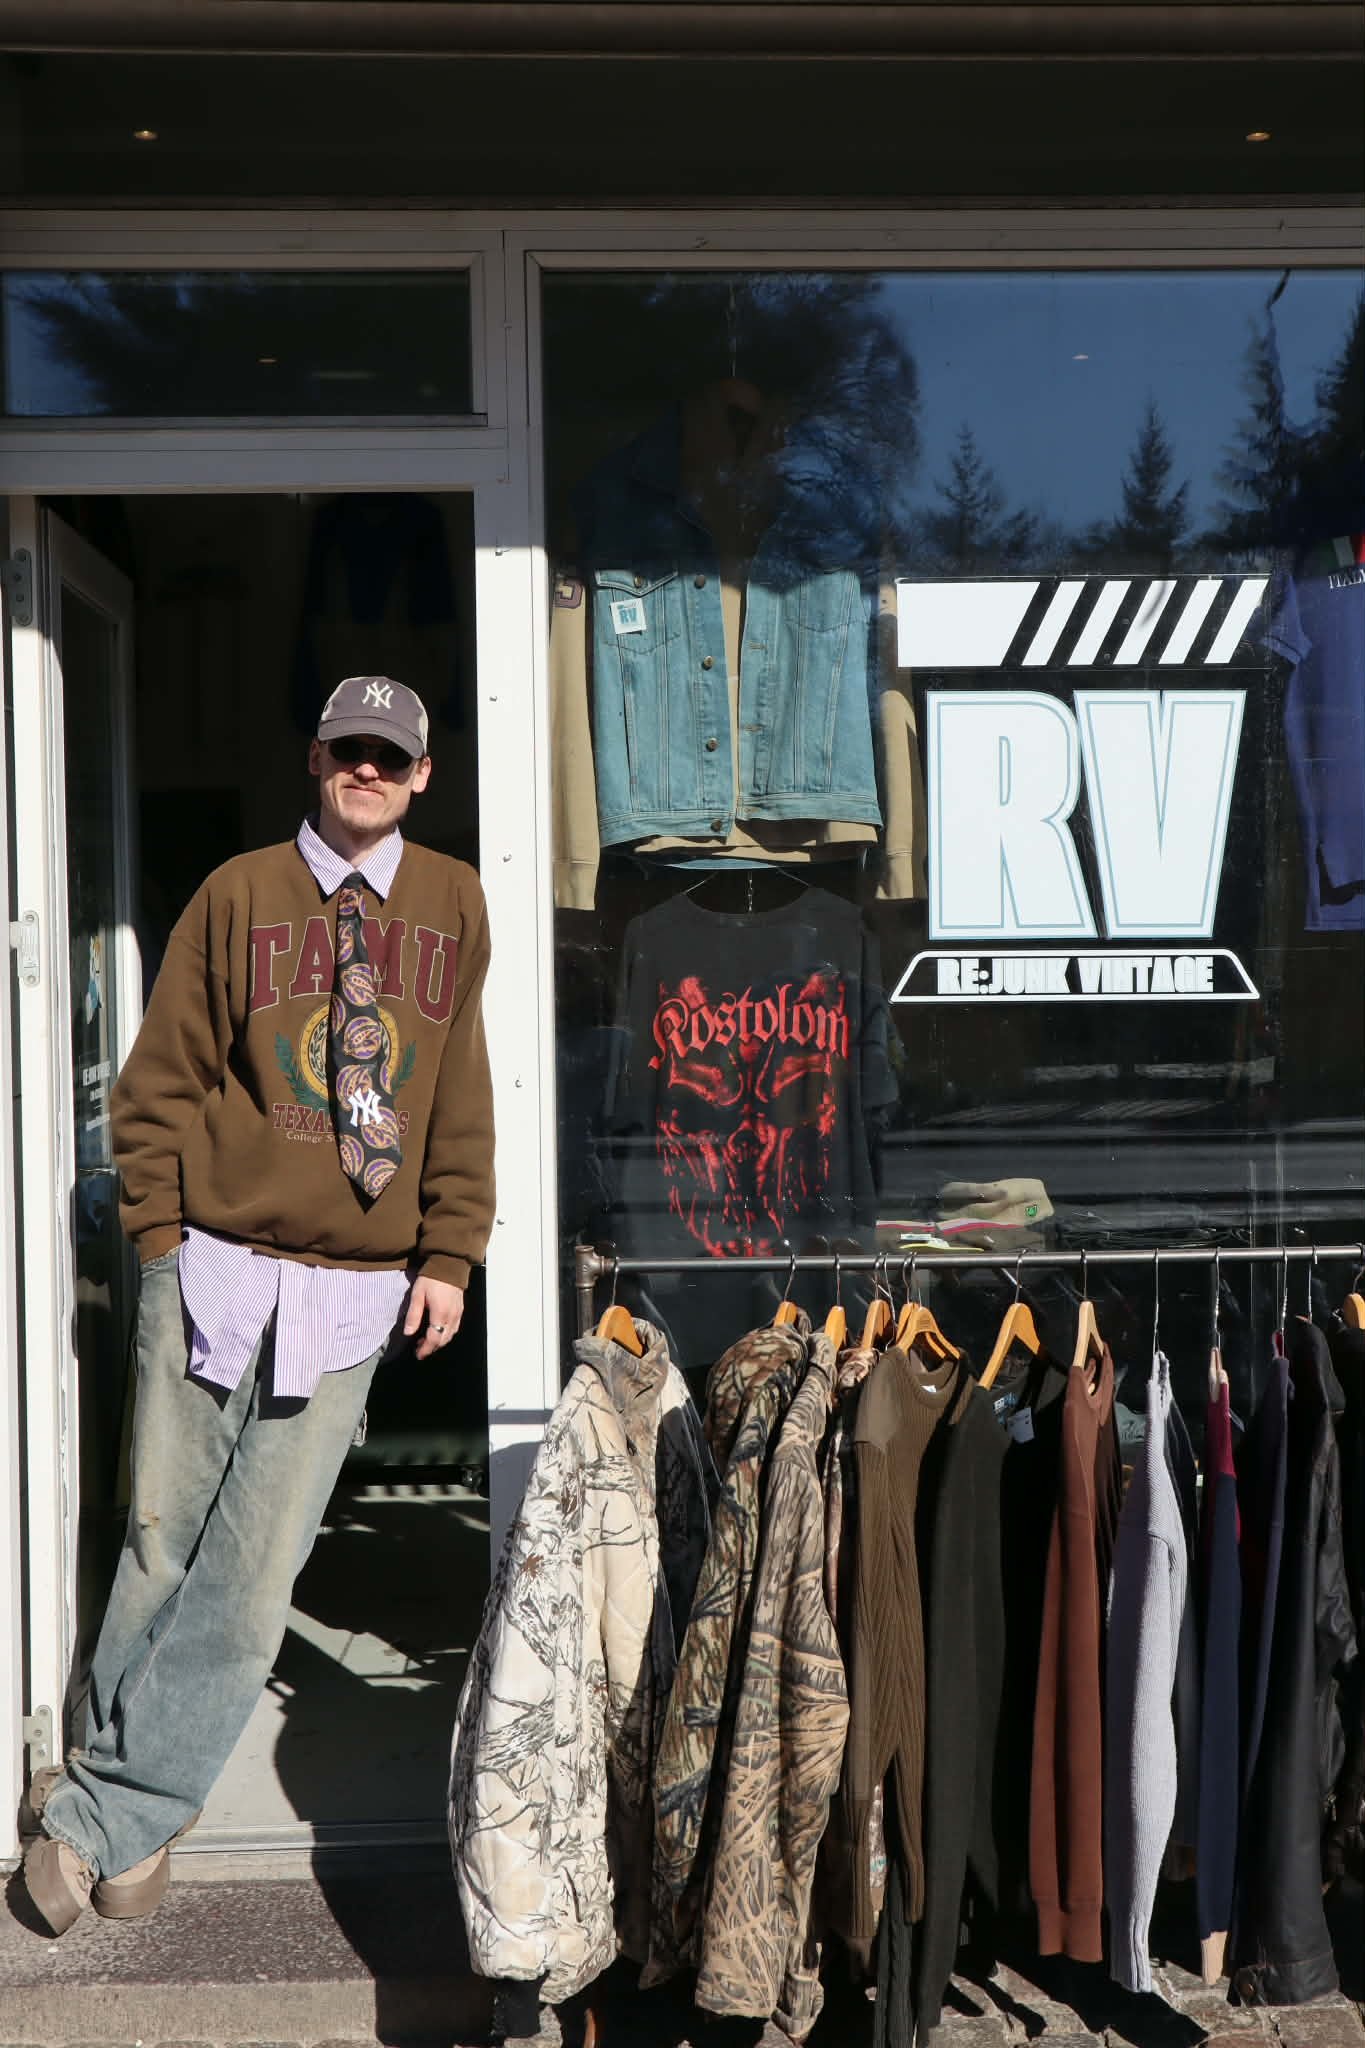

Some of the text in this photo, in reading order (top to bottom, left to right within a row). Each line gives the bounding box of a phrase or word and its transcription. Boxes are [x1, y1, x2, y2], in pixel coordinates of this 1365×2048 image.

[361, 681, 394, 709] NY
[926, 689, 1248, 941] RV
[1077, 956, 1214, 994] VINTAGE
[348, 1087, 384, 1127] NY
